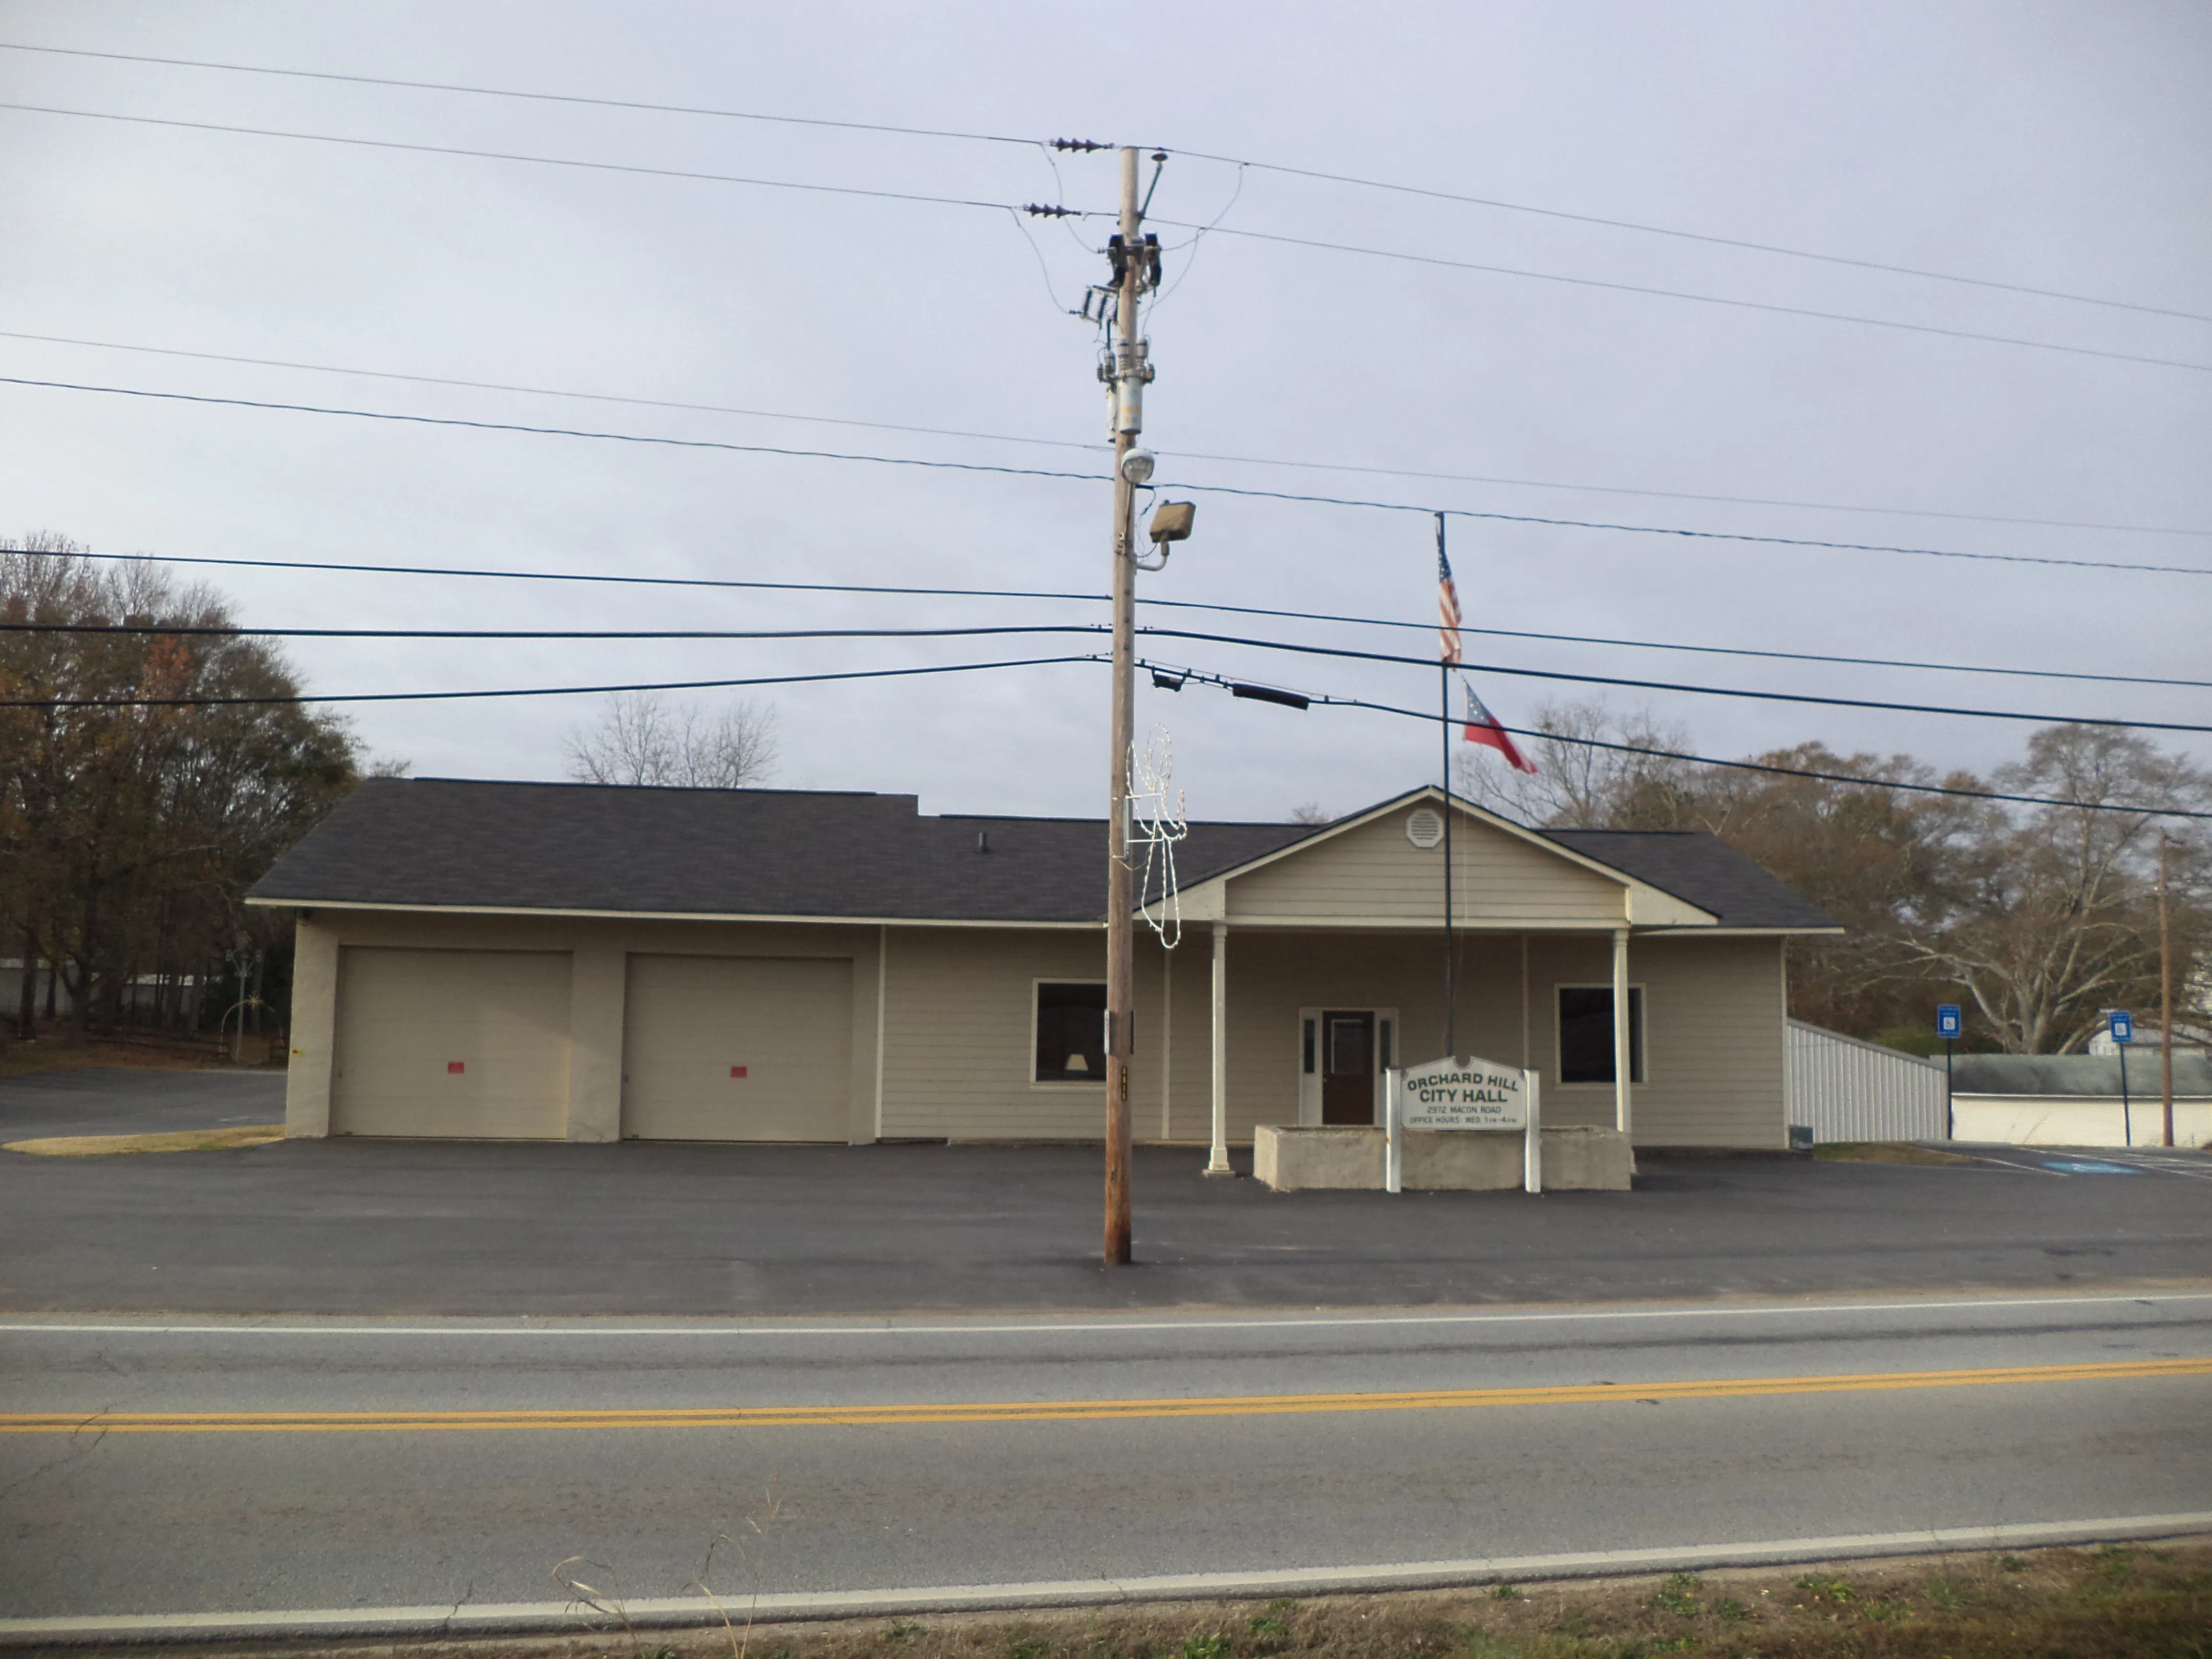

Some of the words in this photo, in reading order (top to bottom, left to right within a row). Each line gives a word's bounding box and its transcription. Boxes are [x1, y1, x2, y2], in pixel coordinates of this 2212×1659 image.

[1408, 1073, 1483, 1091] ORCHARD
[1487, 1075, 1519, 1092] HILL
[1420, 1090, 1457, 1102] CITY
[1463, 1090, 1508, 1102] HALL
